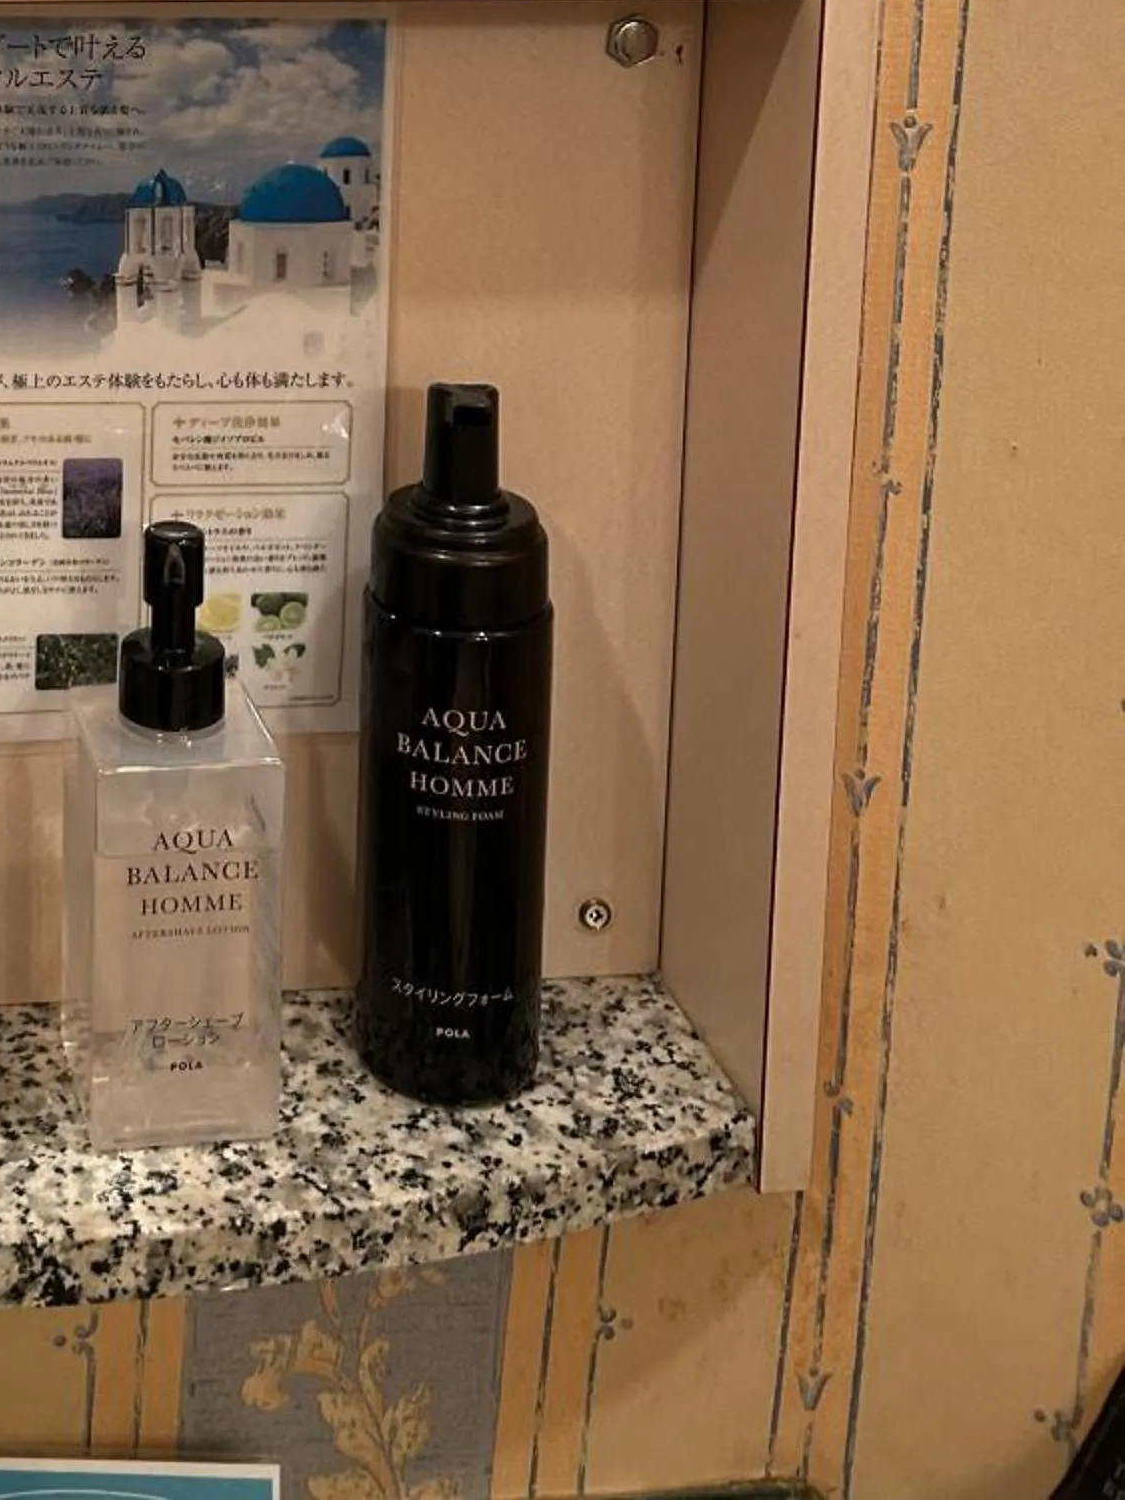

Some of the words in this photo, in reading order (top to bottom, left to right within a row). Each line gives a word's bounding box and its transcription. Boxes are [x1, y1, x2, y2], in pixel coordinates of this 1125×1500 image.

[415, 706, 507, 738] AQUA
[396, 732, 527, 765] BALANCE
[410, 770, 515, 798] HOMME
[154, 828, 235, 855] AQUA
[127, 860, 259, 886] BALANCE
[141, 893, 243, 916] HOMME
[391, 976, 515, 1008] スタイリングフォーム
[436, 1026, 471, 1040] POLA
[170, 1061, 204, 1072] POLA
